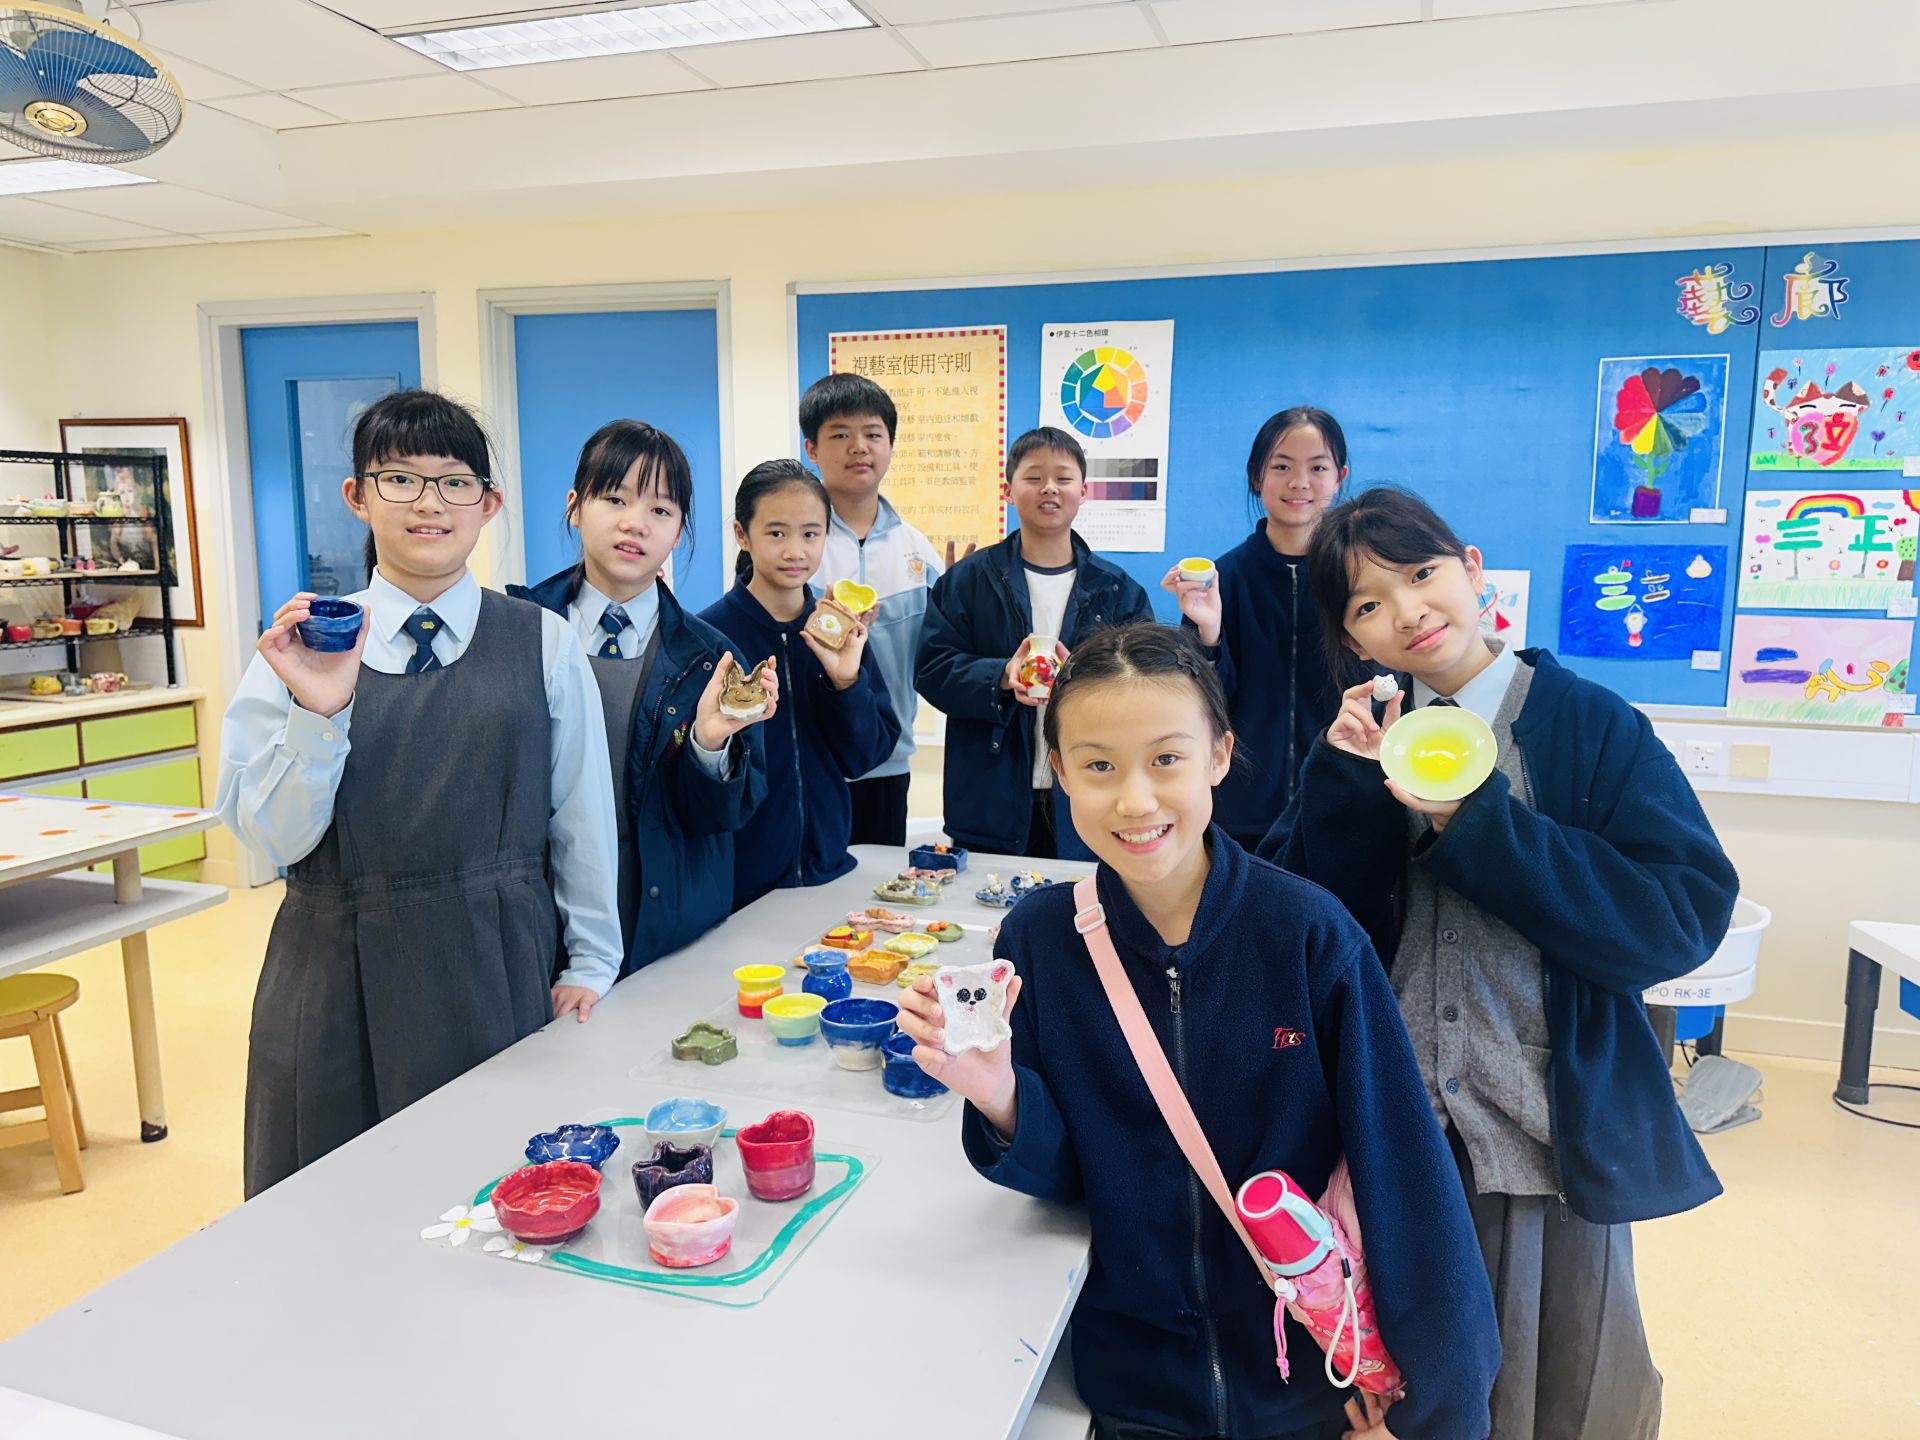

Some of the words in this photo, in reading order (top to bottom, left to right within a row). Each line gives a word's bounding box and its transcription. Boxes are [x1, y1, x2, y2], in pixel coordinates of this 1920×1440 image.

[852, 352, 971, 376] 視藝室使用守則
[1674, 988, 1712, 998] RK-3E
